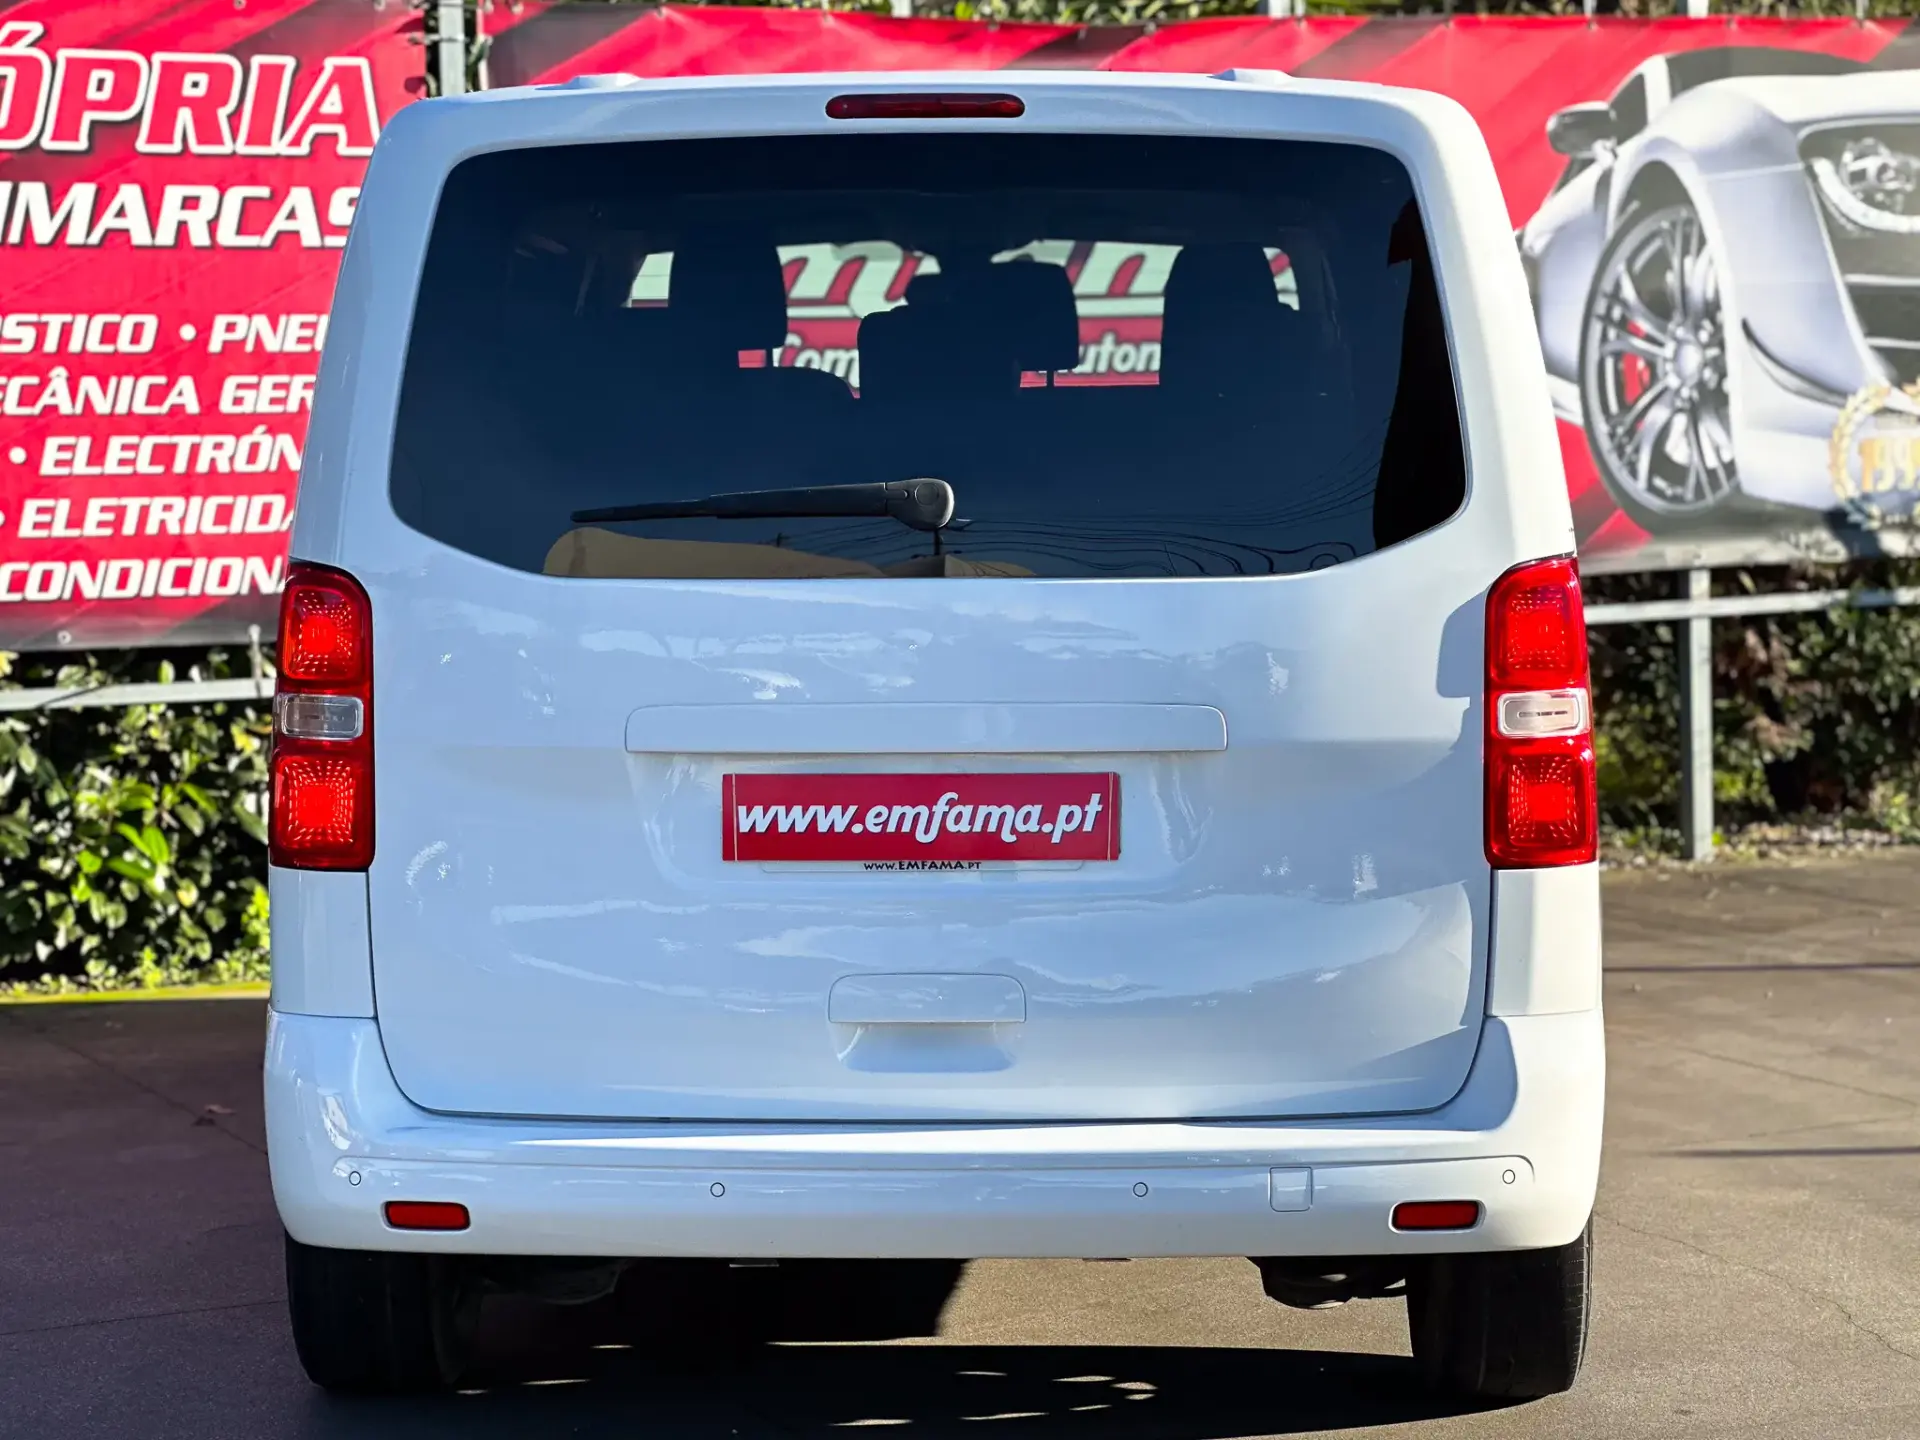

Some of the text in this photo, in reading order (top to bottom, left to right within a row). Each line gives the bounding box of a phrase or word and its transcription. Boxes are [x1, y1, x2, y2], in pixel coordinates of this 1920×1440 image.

[0, 314, 158, 353] STICO
[0, 366, 199, 415] CÂNICA
[39, 425, 303, 476] ELECTRÓN
[0, 556, 286, 602] CONDICION
[738, 792, 1102, 844] www.emfama.pt
